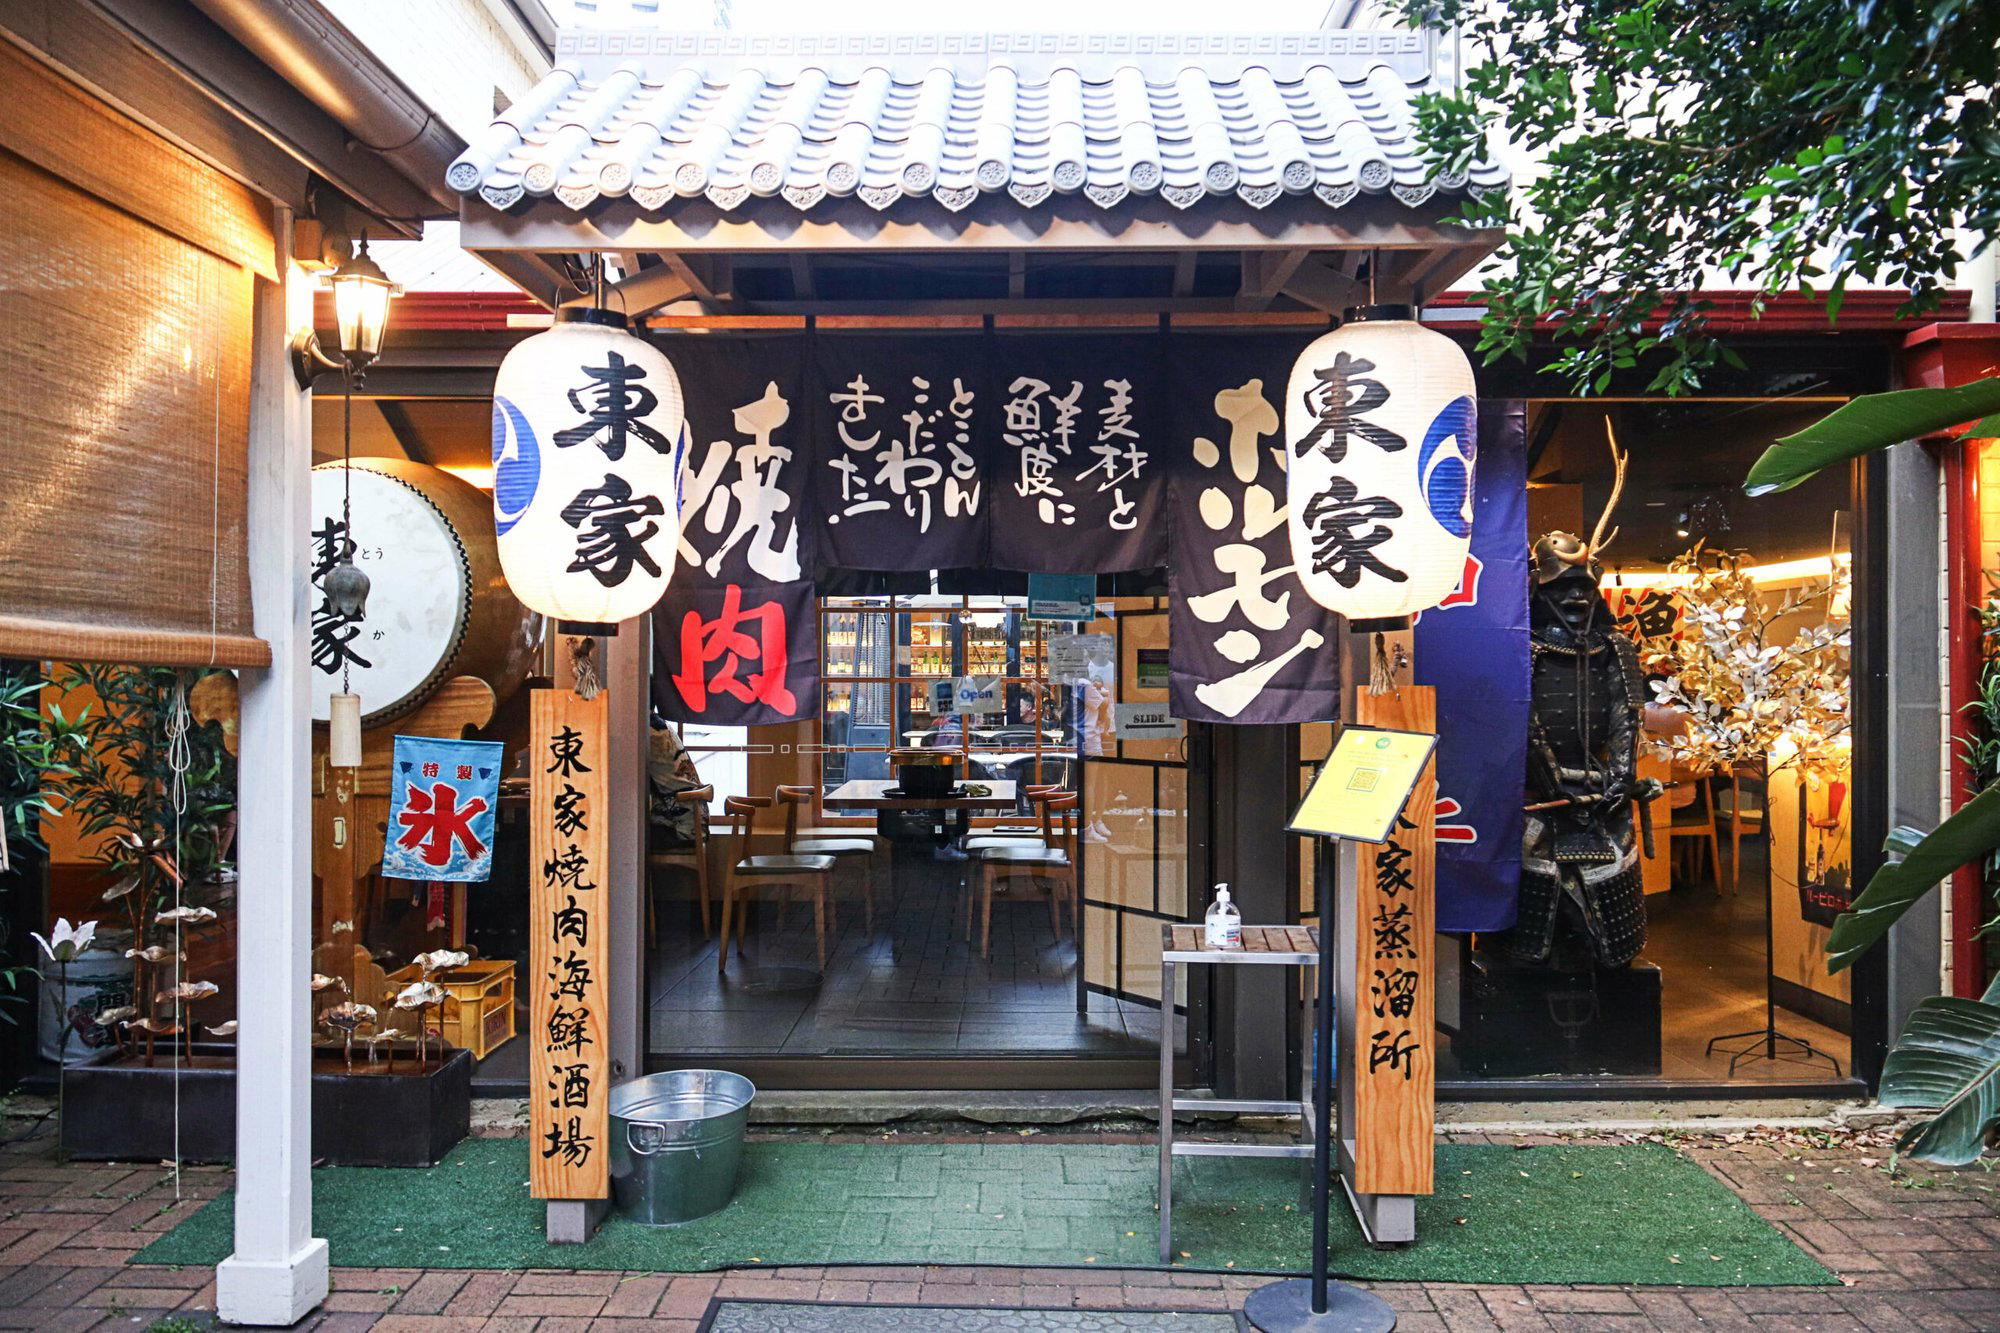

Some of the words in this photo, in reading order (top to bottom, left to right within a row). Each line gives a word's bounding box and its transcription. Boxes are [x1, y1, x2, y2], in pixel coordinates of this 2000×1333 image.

[553, 352, 671, 587] 東家
[875, 376, 943, 534] こだわり
[944, 378, 981, 518] とことん
[1003, 376, 1083, 525] 鮮度に
[1295, 351, 1409, 589] 東家
[361, 548, 384, 560] とう
[1186, 378, 1324, 718] ホルモン
[421, 762, 473, 781] 特製
[1133, 714, 1165, 724] SLIDE
[397, 782, 488, 867] 氷
[543, 725, 597, 1168] 東家焼肉海鮮酒場
